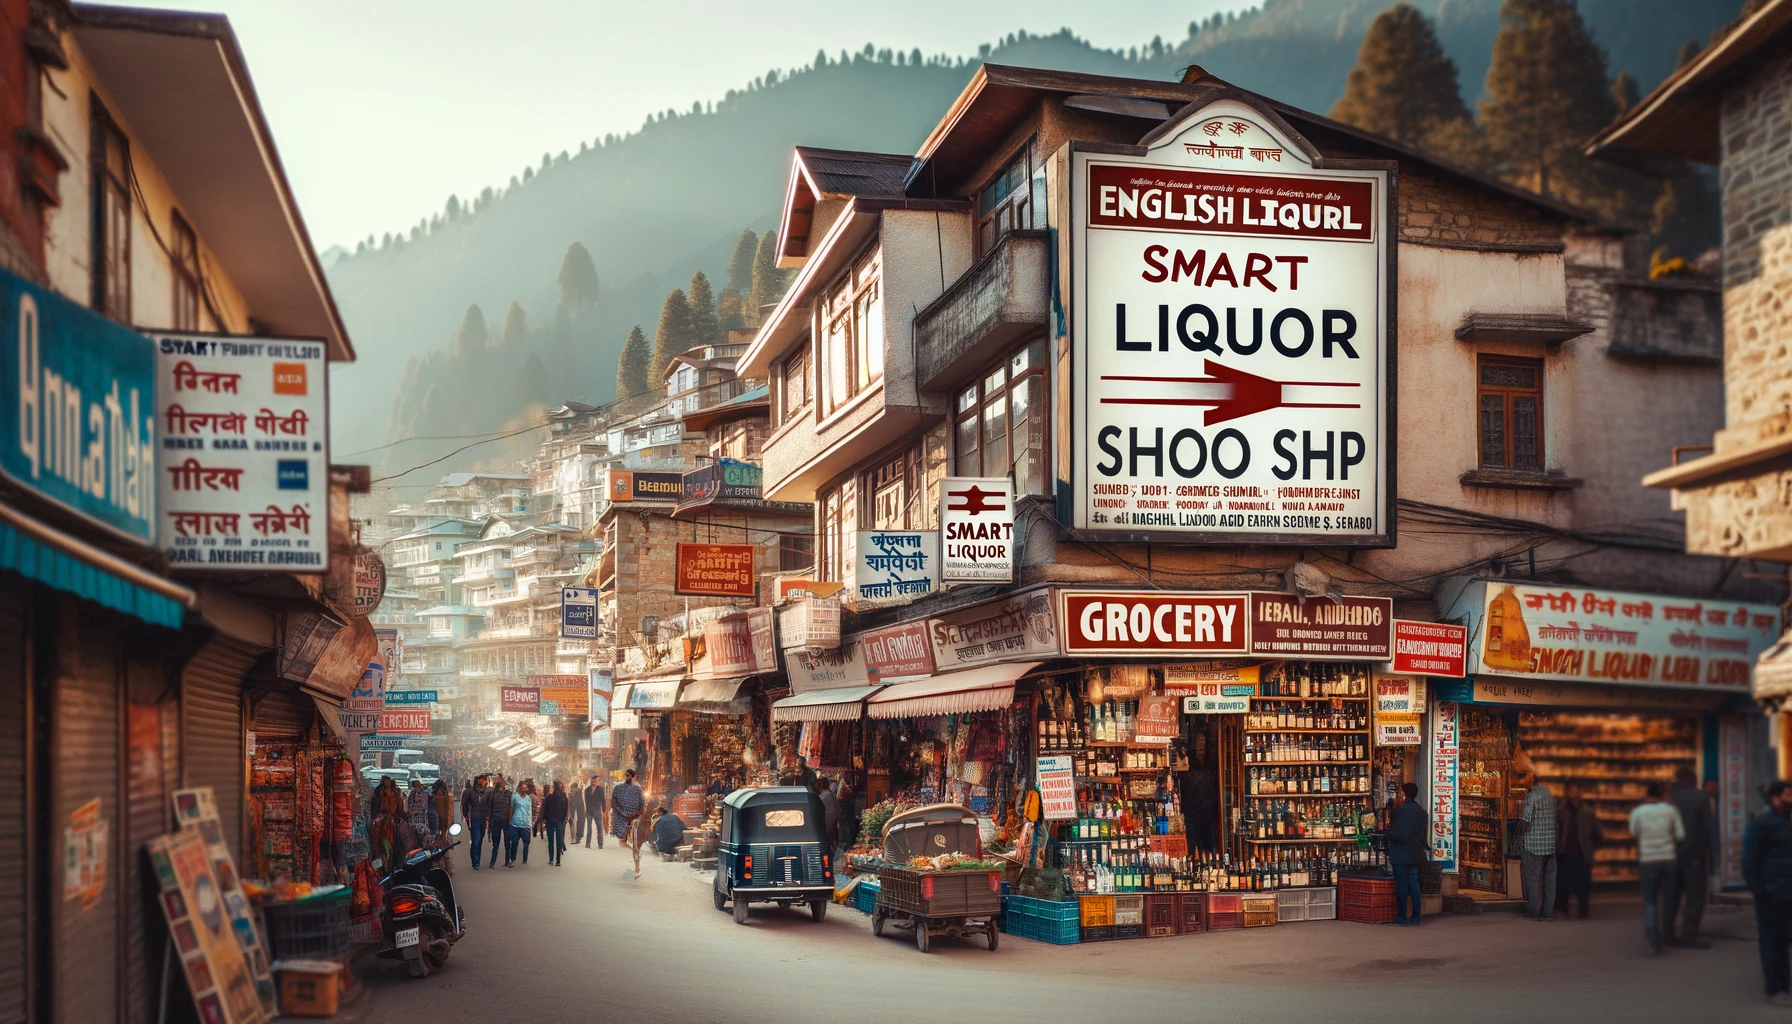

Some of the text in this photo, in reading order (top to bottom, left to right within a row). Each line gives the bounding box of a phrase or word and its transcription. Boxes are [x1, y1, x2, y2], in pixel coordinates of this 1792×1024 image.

[1100, 185, 1235, 225] ENGLISH
[1242, 197, 1363, 231] LIQURL
[1141, 244, 1309, 293] SMART
[1115, 302, 1361, 358] LIQUOR
[1096, 425, 1367, 481] SHOO SHP
[946, 522, 1014, 541] SMART
[947, 544, 1006, 563] LIQUOR
[1080, 600, 1238, 643] GROCERY
